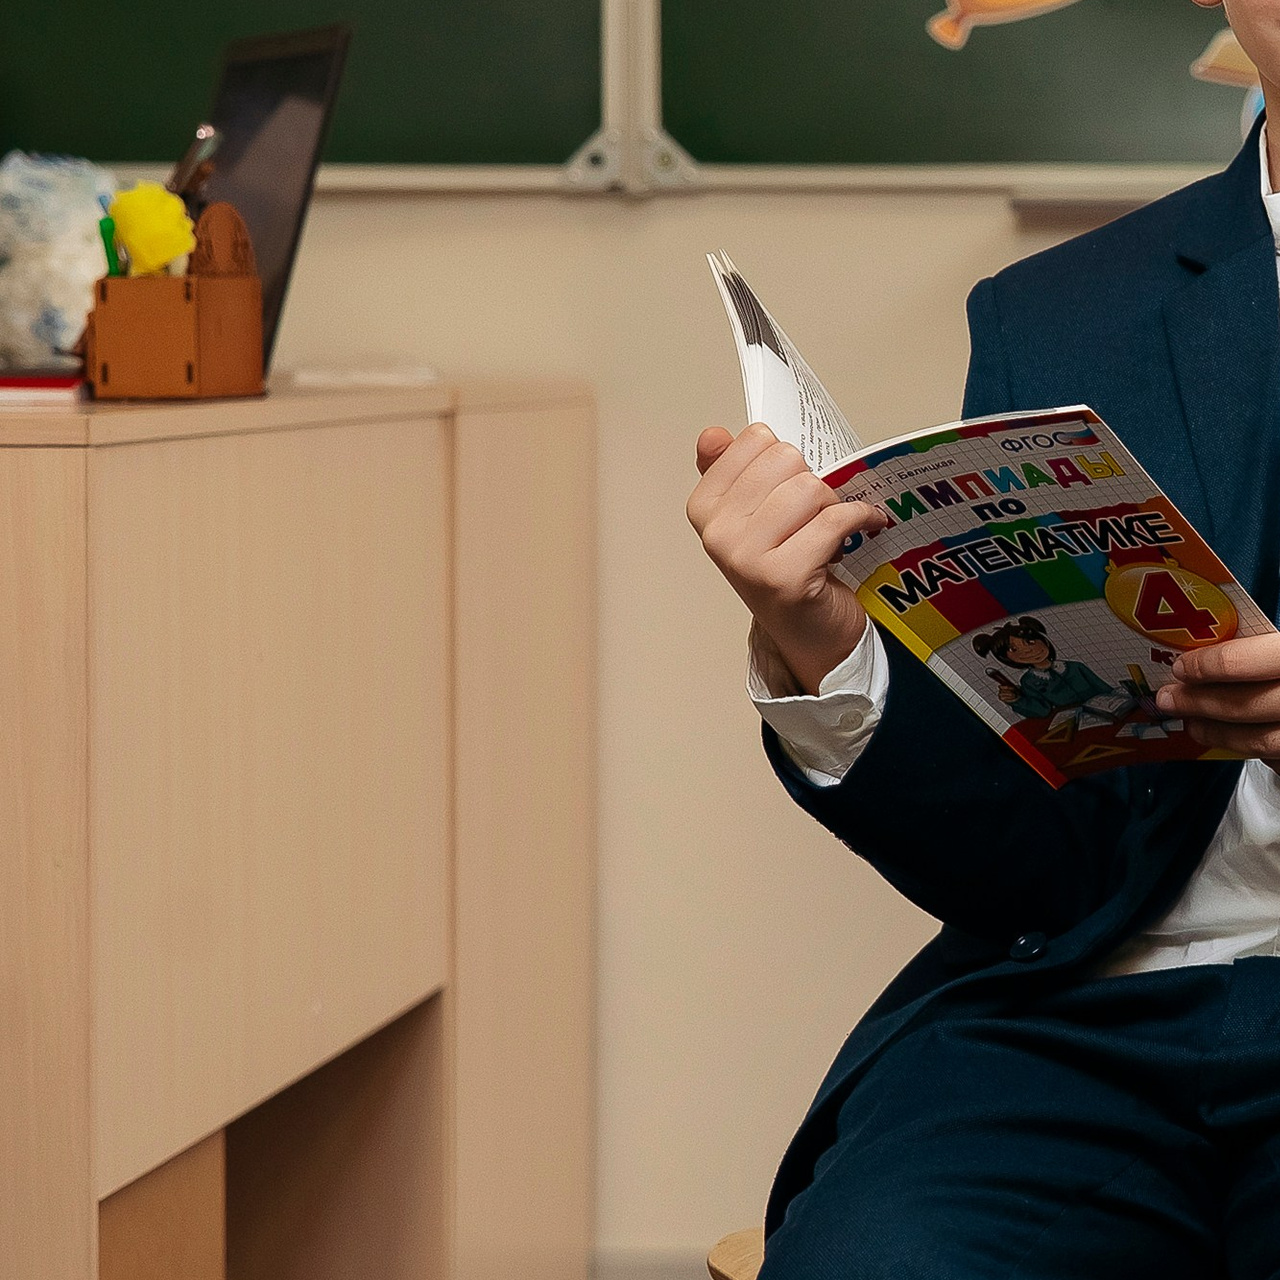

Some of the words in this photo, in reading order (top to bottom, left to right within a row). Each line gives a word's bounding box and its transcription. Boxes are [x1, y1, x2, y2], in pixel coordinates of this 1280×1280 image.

[1000, 431, 1072, 453] ФГОС
[899, 458, 957, 481] Белицкая
[875, 511, 1185, 614] МАТЕМАТИКЕ
[1133, 569, 1220, 642] 4
